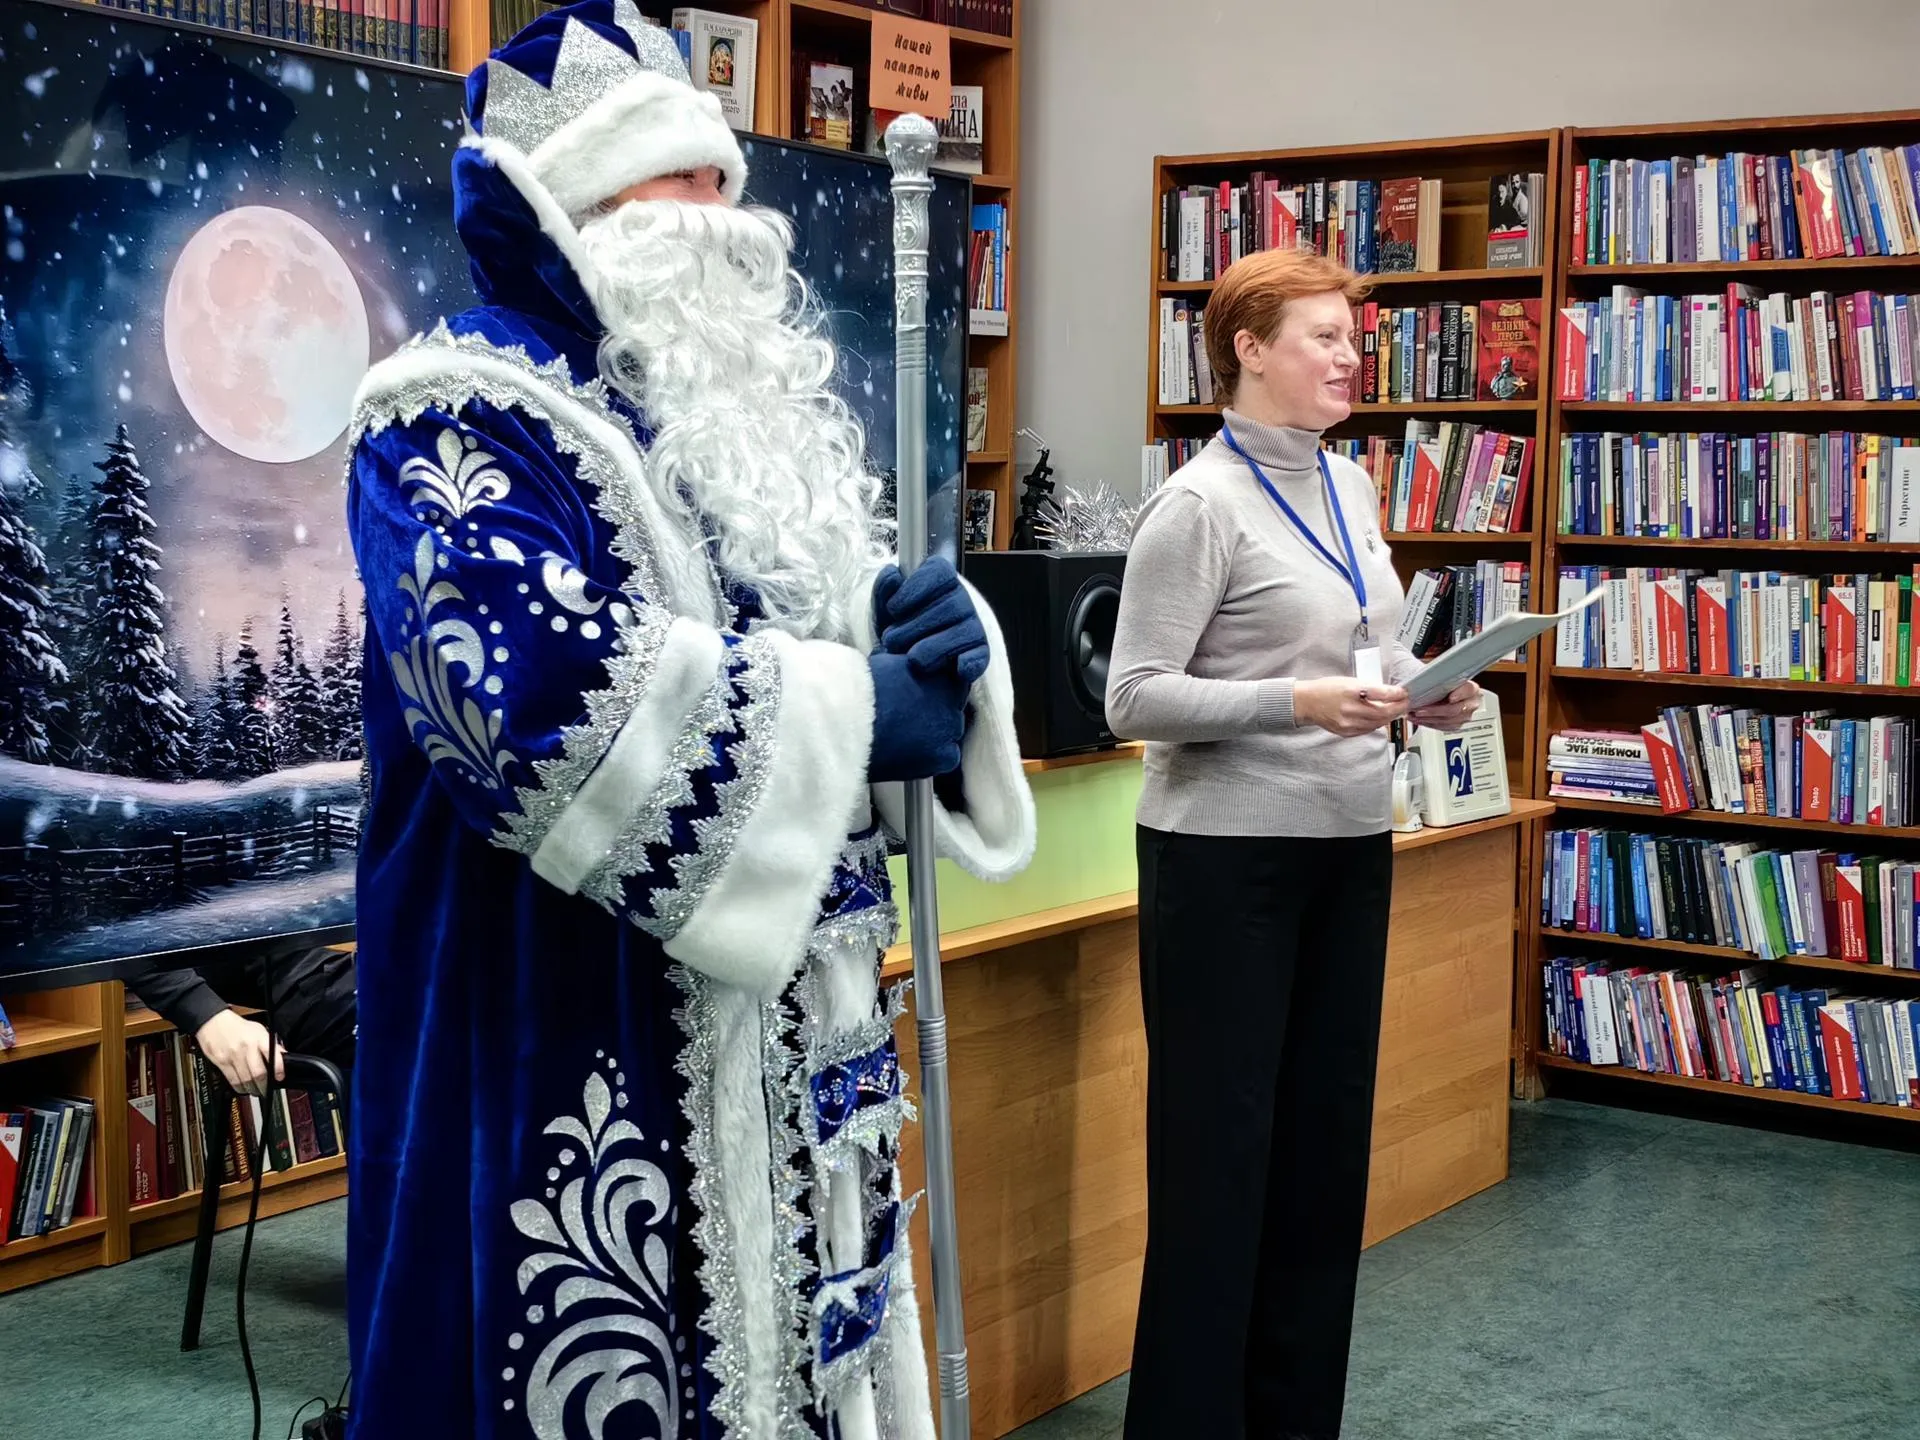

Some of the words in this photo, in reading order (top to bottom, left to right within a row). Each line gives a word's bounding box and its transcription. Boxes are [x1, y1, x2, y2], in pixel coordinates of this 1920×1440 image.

[894, 33, 932, 56] Нашей
[882, 58, 941, 80] памятью
[895, 82, 929, 103] живы
[1696, 183, 1705, 231] Инвестиции
[1448, 309, 1458, 355] КОЖЕДУБ
[1497, 331, 1523, 341] ГЕРОЕВ
[1366, 355, 1376, 394] ЖУКОВ
[1897, 466, 1911, 527] Маркетинг
[1791, 586, 1801, 630] ГЕОГРАФИЯ
[1648, 617, 1656, 661] Управление
[1856, 616, 1866, 647] МИРОВОЙ
[1856, 648, 1865, 677] ИСТОРИЯ
[1816, 732, 1826, 740] 67
[1872, 730, 1880, 757] ОСНОВЫ
[1592, 746, 1641, 759] ПОМЯНИ
[1856, 767, 1864, 789] Право
[1872, 758, 1880, 780] ПРАВА
[1810, 786, 1820, 809] Право
[1578, 854, 1587, 911] ПРАВОВЕДЕНИЕ
